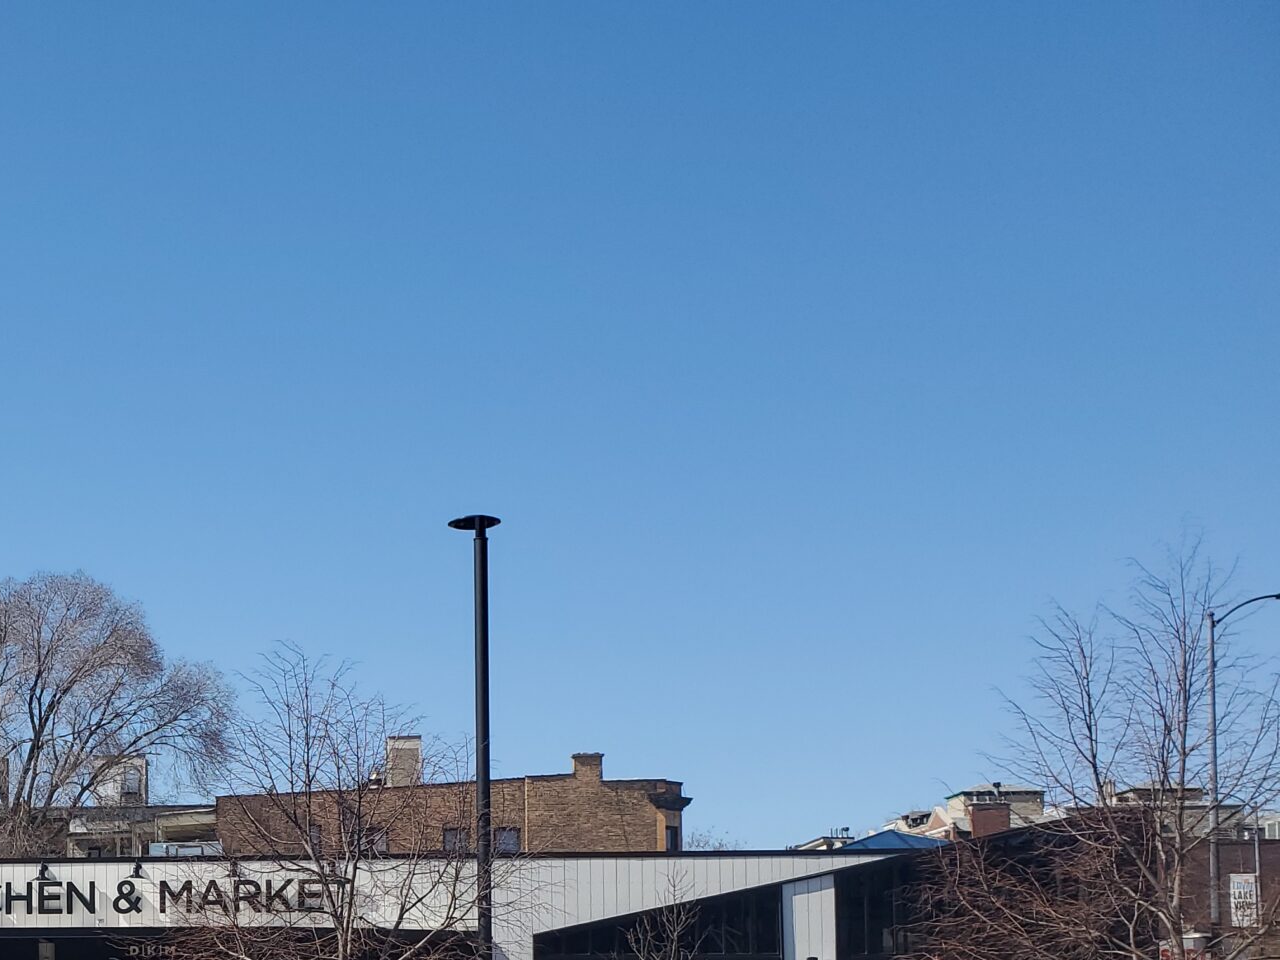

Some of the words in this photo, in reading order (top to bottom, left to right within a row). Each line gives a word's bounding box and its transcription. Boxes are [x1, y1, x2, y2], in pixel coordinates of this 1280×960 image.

[112, 879, 142, 915] &
[159, 878, 353, 914] MARKET
[1233, 890, 1253, 900] LAKE
